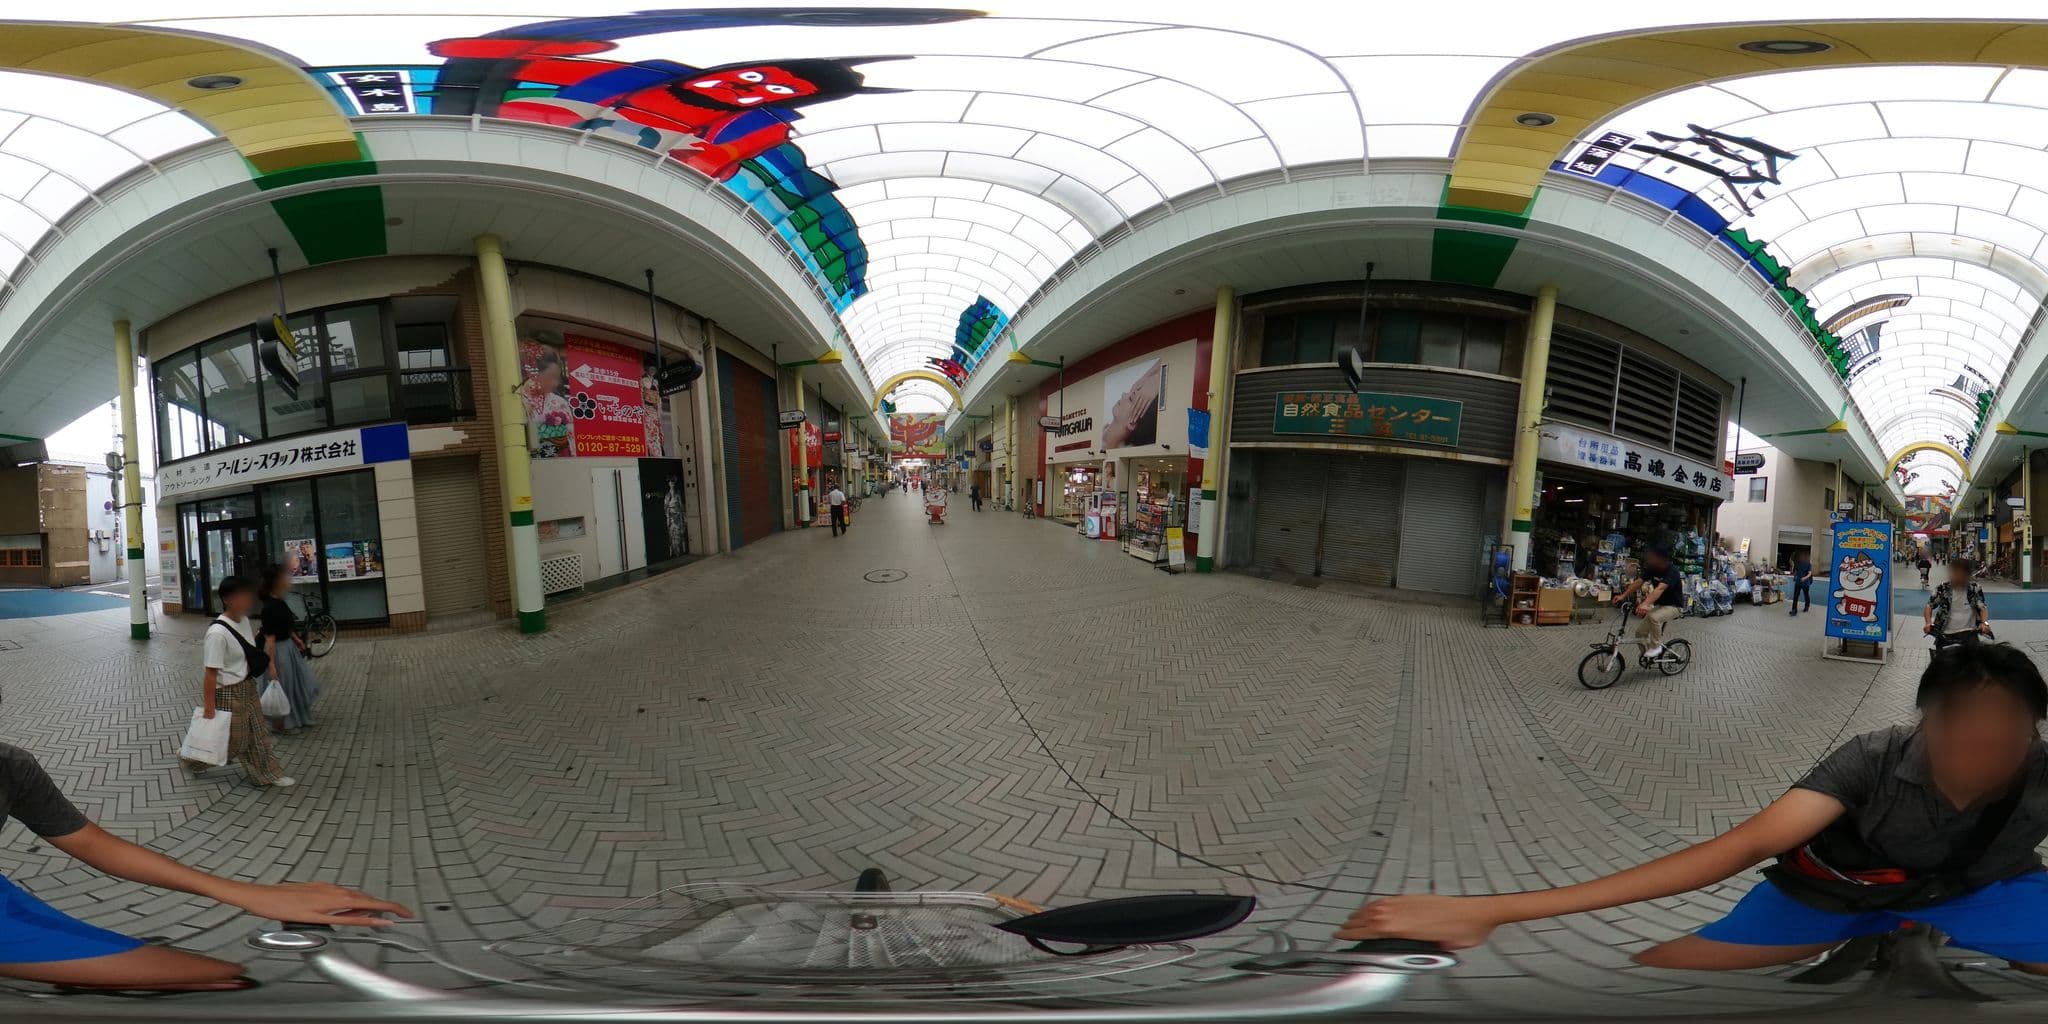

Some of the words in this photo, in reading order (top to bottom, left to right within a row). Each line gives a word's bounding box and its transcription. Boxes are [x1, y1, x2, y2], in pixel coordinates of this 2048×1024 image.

[346, 74, 405, 112] 女木島
[1283, 402, 1454, 425] 自然食品センター
[216, 440, 356, 478] アールシースタッフ株式会社
[1624, 451, 1722, 493] 高嶋金物店
[165, 476, 211, 491] アウトソーシング
